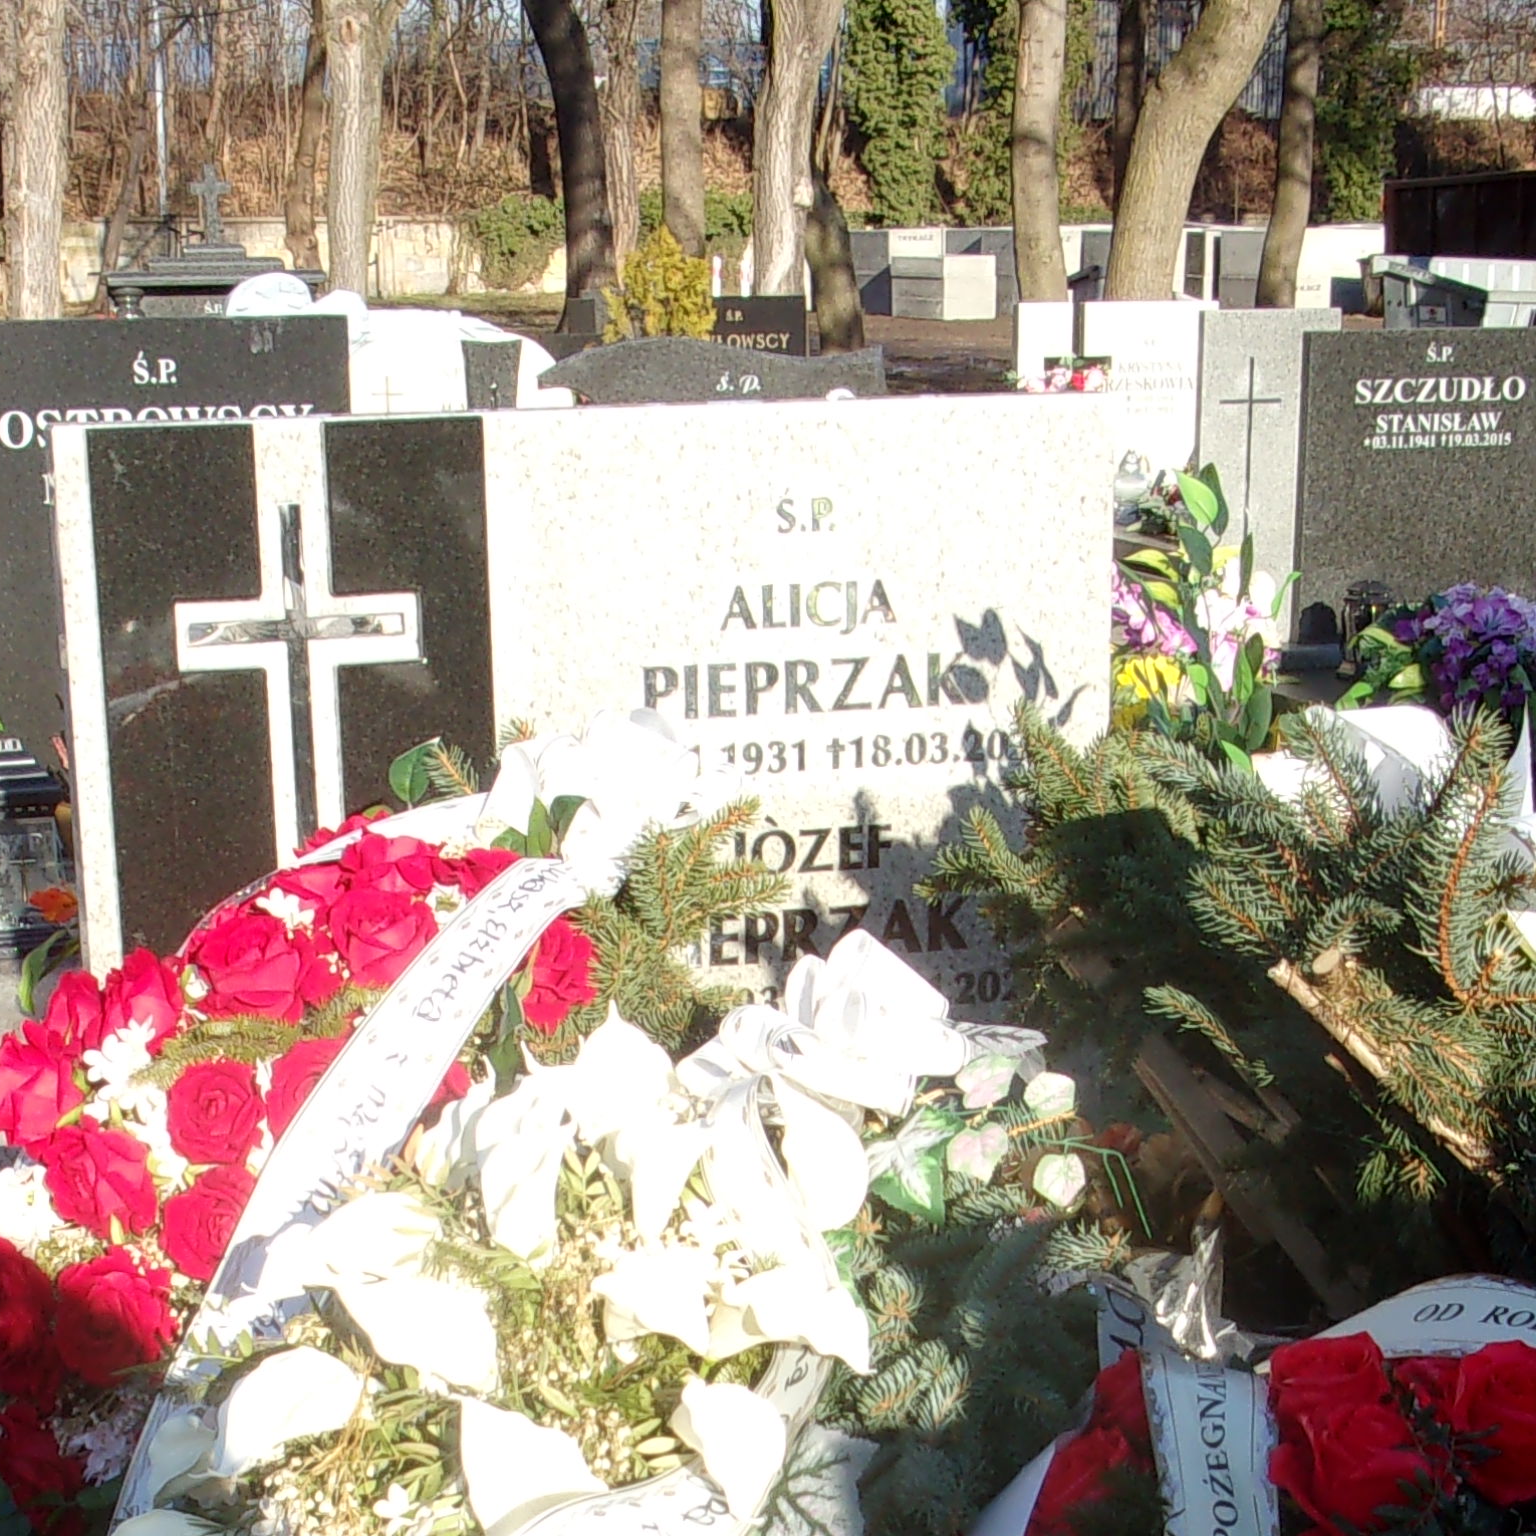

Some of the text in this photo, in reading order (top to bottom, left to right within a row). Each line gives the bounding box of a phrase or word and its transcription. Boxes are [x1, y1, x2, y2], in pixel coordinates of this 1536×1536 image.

[1426, 340, 1455, 363] Ś.P.
[131, 350, 178, 386] Ś.P.
[1354, 375, 1527, 405] SZCZUDŁO
[1375, 410, 1503, 434] STANISŁAW
[720, 578, 898, 635] ALICJA
[642, 651, 978, 720] PIEPRZAK
[1413, 1299, 1465, 1325] OD
